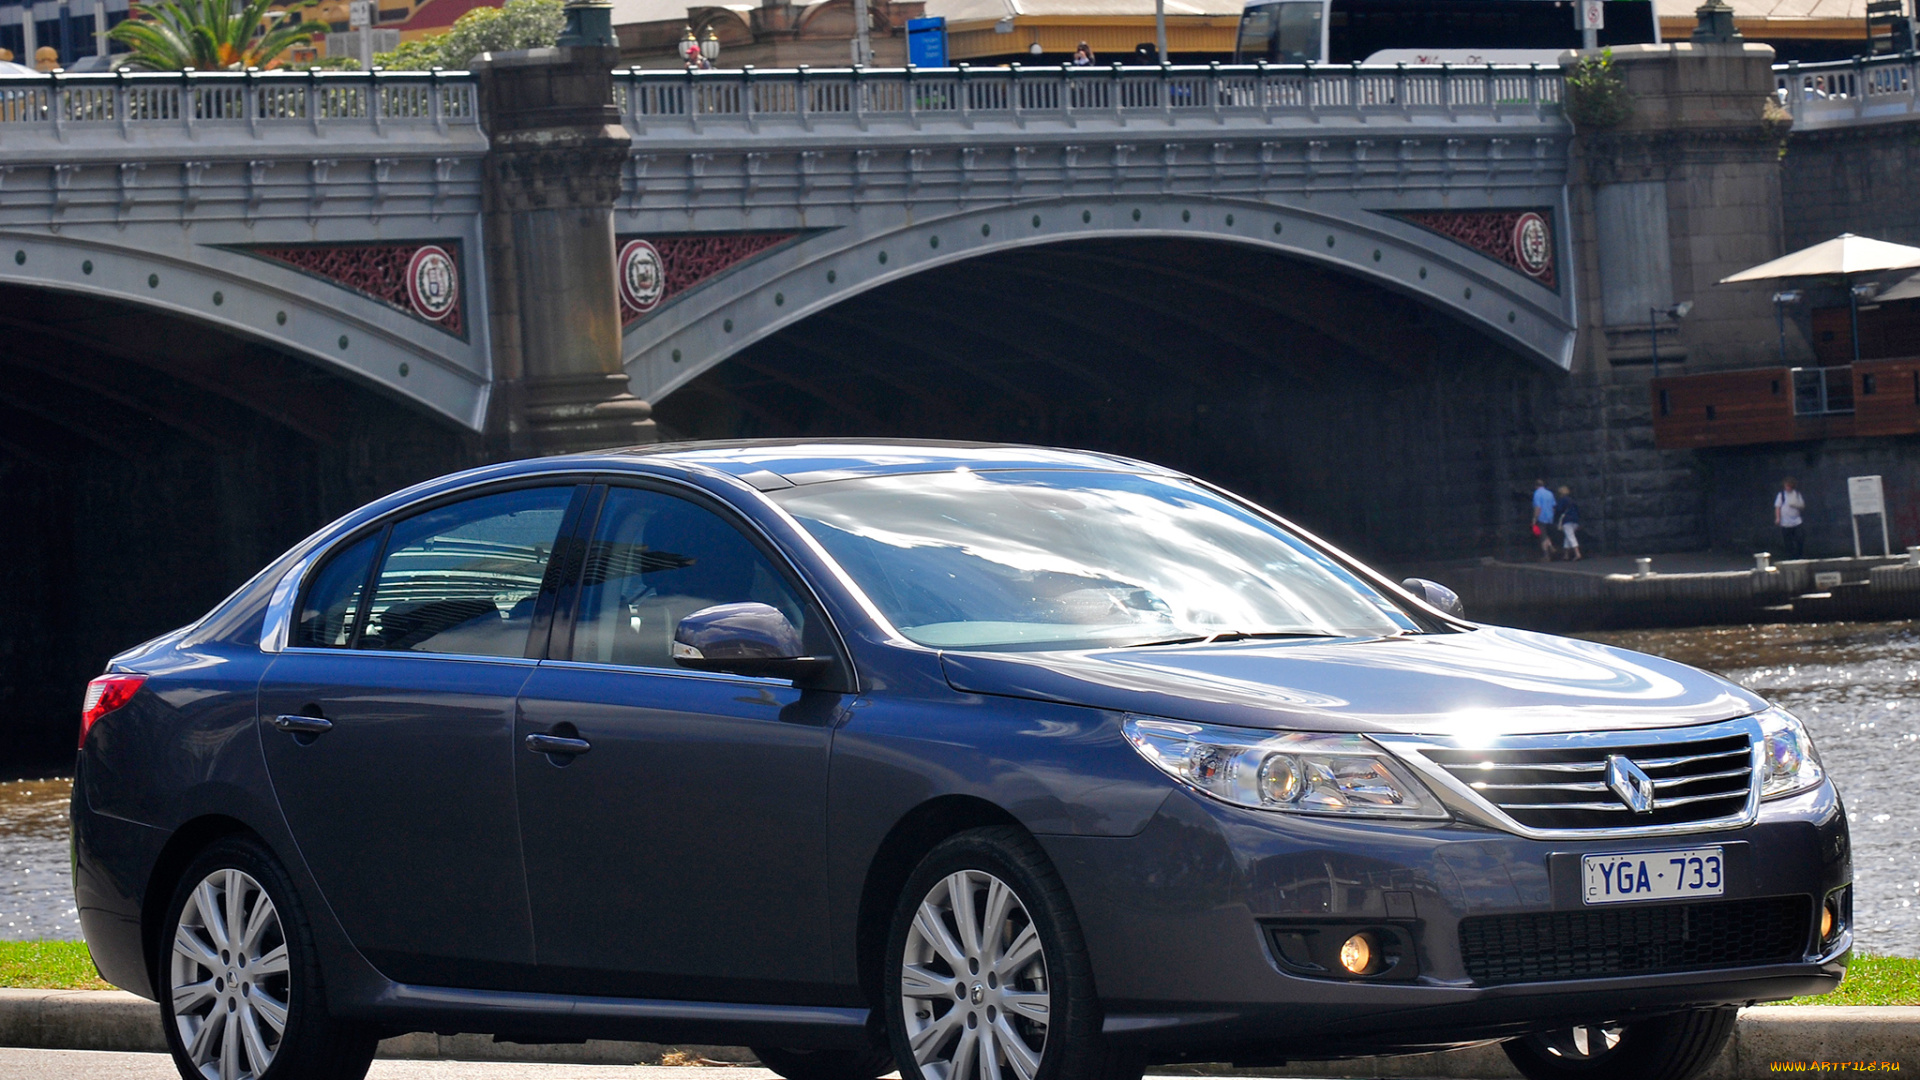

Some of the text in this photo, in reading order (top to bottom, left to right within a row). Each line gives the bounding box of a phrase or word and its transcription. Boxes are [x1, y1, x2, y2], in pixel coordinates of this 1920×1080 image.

[1588, 863, 1597, 896] VIC
[1599, 856, 1721, 895] YGA 733
